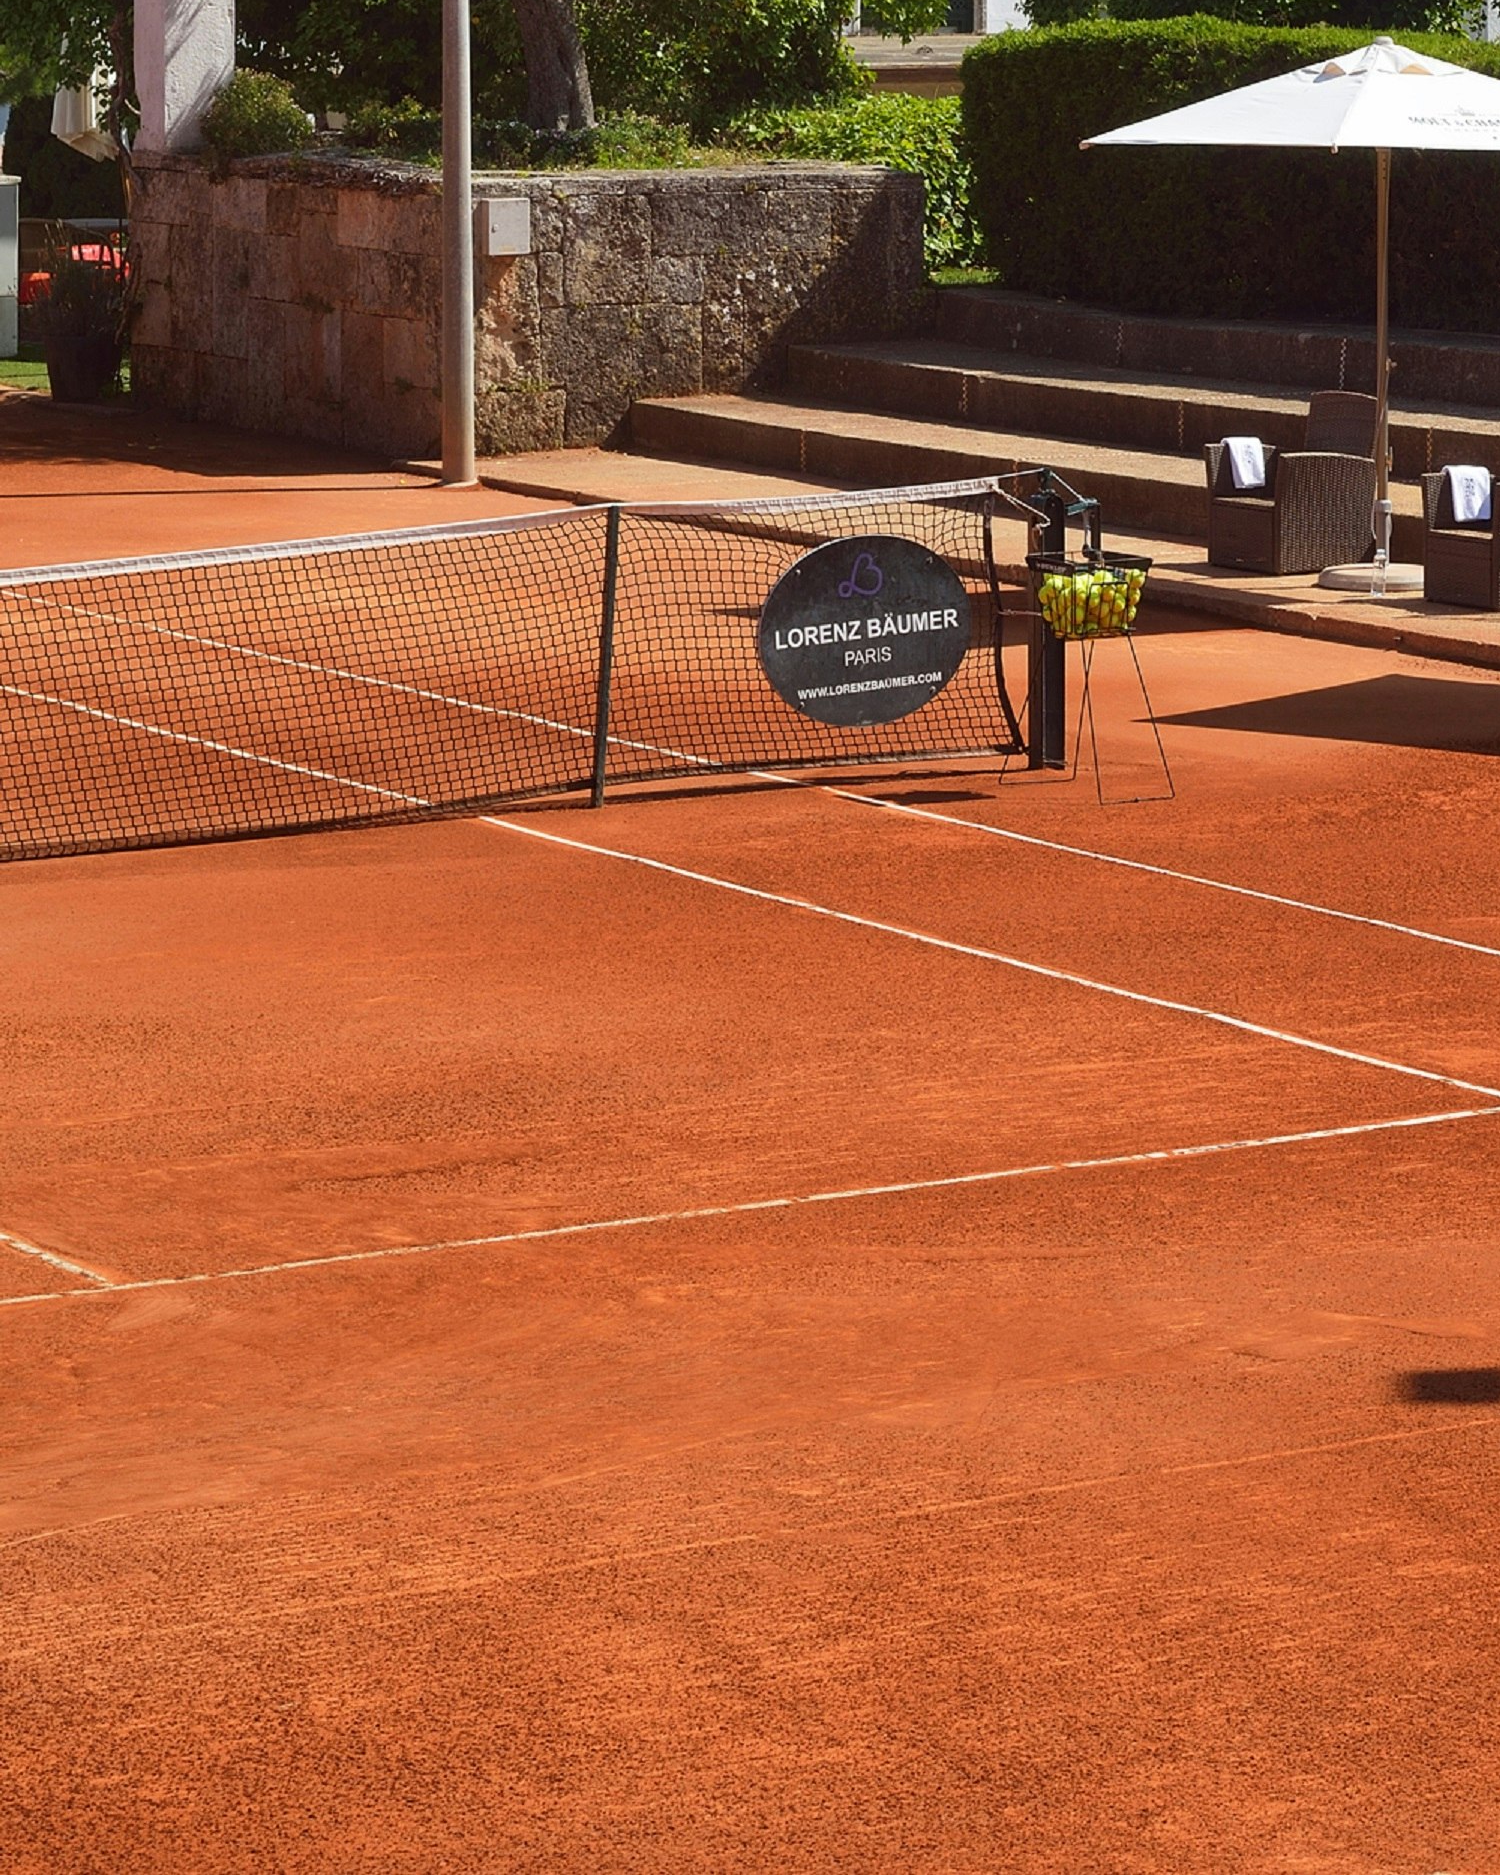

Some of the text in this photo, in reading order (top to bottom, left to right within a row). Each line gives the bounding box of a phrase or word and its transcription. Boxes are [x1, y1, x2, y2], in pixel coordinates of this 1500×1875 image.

[775, 609, 959, 650] LORENZ BÄUMER
[845, 646, 892, 666] PARIS
